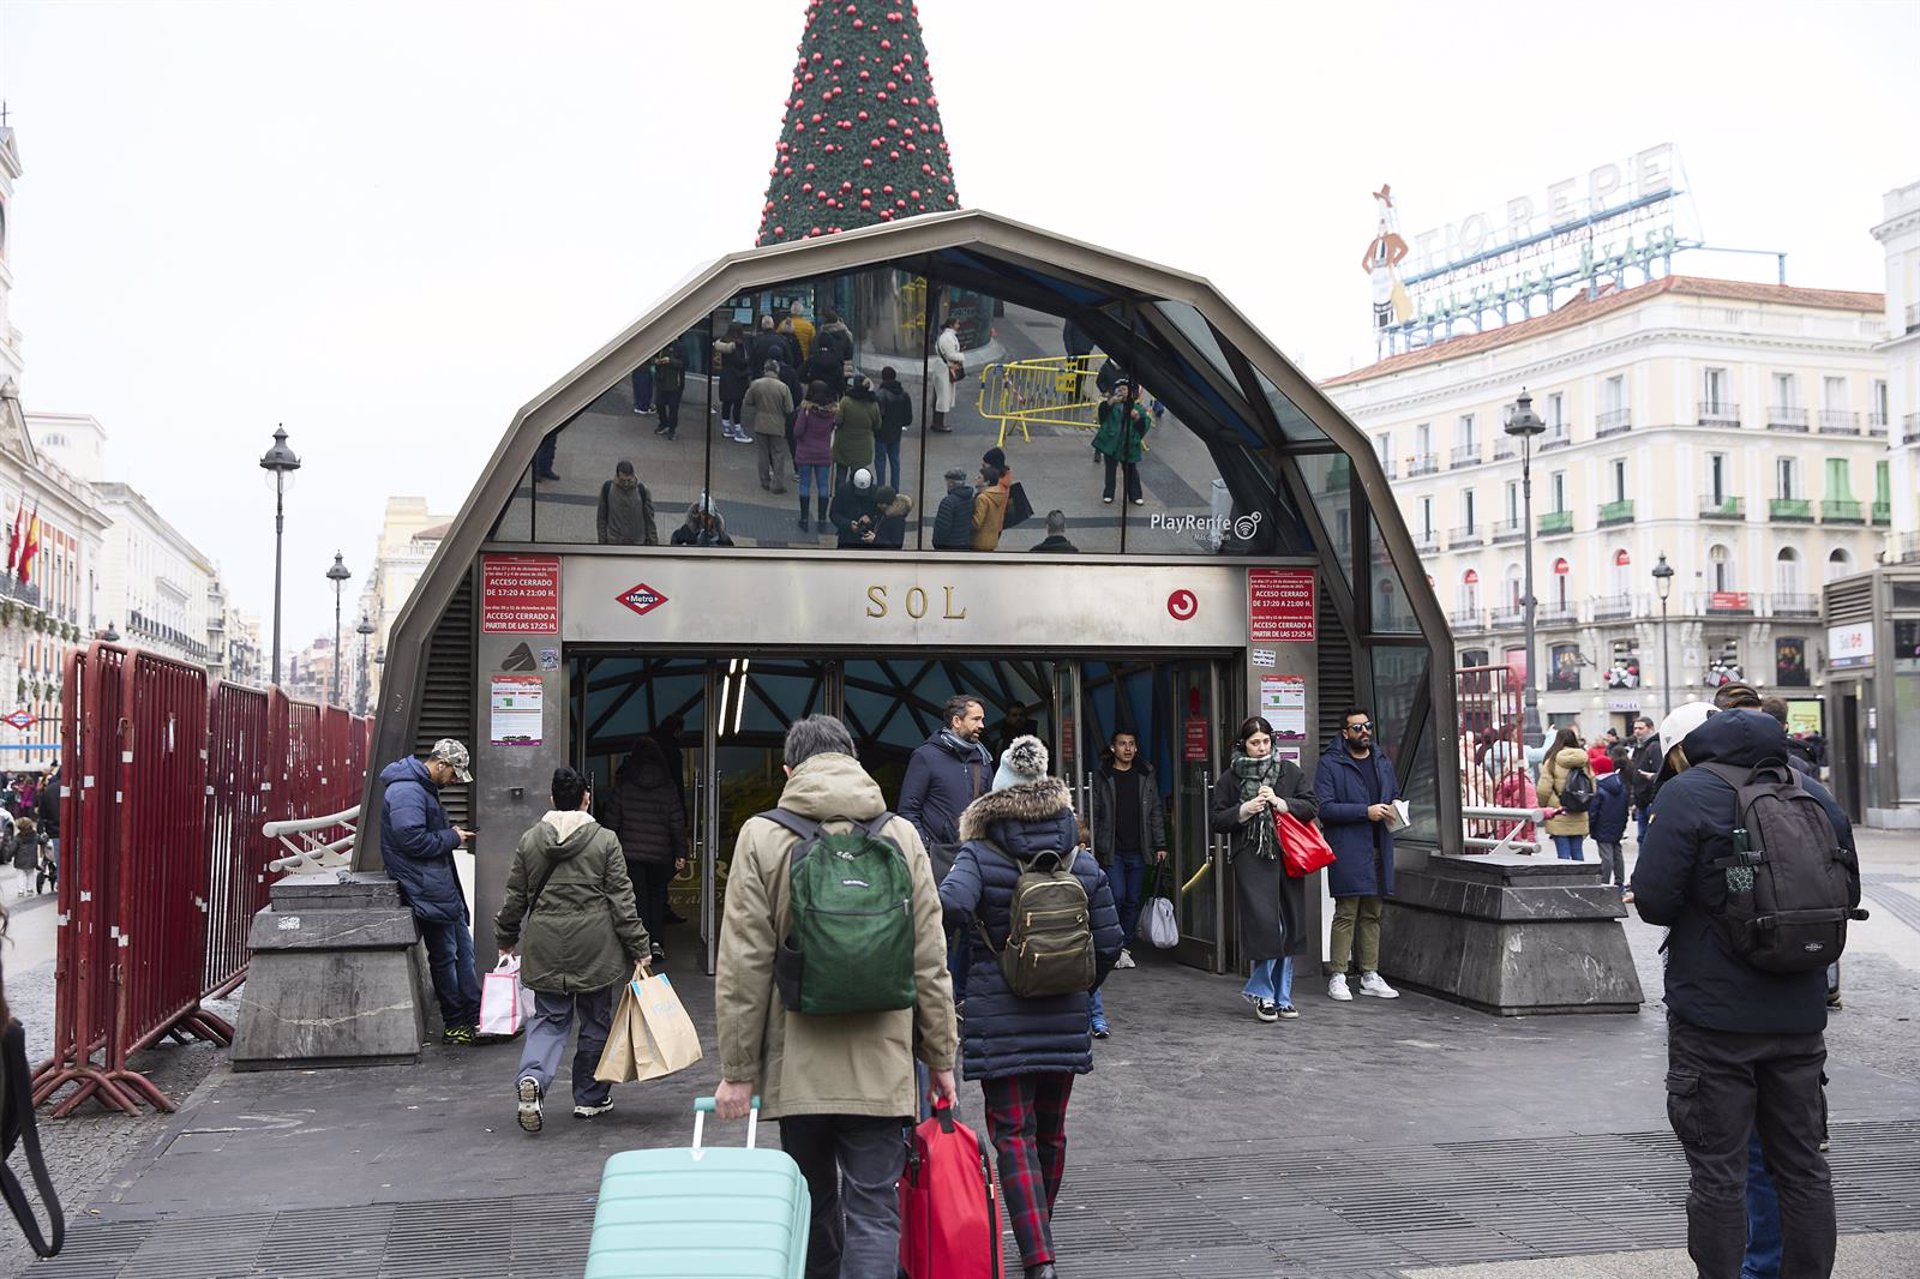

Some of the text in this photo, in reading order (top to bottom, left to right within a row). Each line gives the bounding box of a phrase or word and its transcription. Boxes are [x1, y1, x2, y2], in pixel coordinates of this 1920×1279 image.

[1150, 513, 1231, 533] PlayRenfe
[519, 579, 553, 587] CERRADO
[630, 594, 654, 603] Metro
[866, 585, 966, 619] SOL
[515, 612, 549, 620] CERRADO
